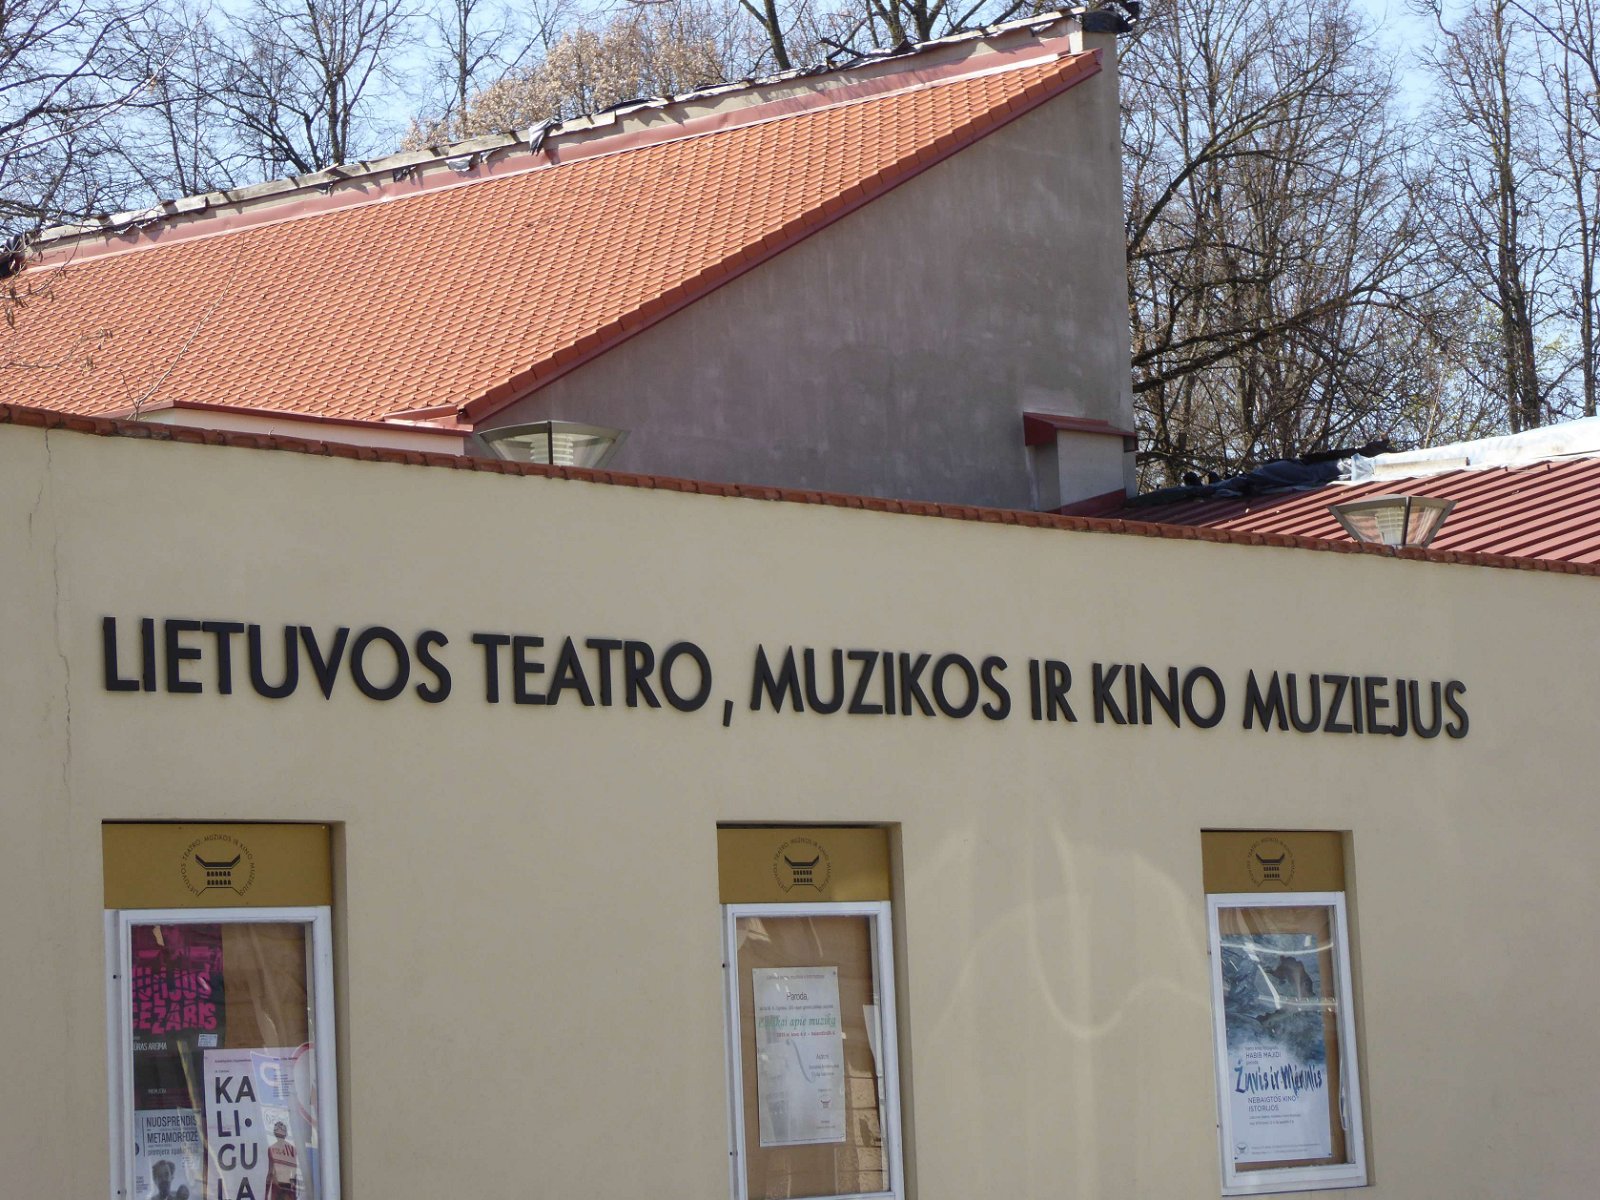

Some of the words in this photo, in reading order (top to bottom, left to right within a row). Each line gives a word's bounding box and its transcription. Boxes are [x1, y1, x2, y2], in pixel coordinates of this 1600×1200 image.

[102, 617, 451, 703] LIETUVOS
[471, 633, 733, 727] TEATRO,
[750, 644, 1011, 720] MUZIKOS
[1029, 660, 1077, 722] IR
[1092, 663, 1225, 728] KINO
[1243, 669, 1469, 739] MUZIEJUS
[215, 1075, 257, 1104] KA
[1248, 1096, 1281, 1104] NEBAIGTOS
[217, 1142, 258, 1171] GU
